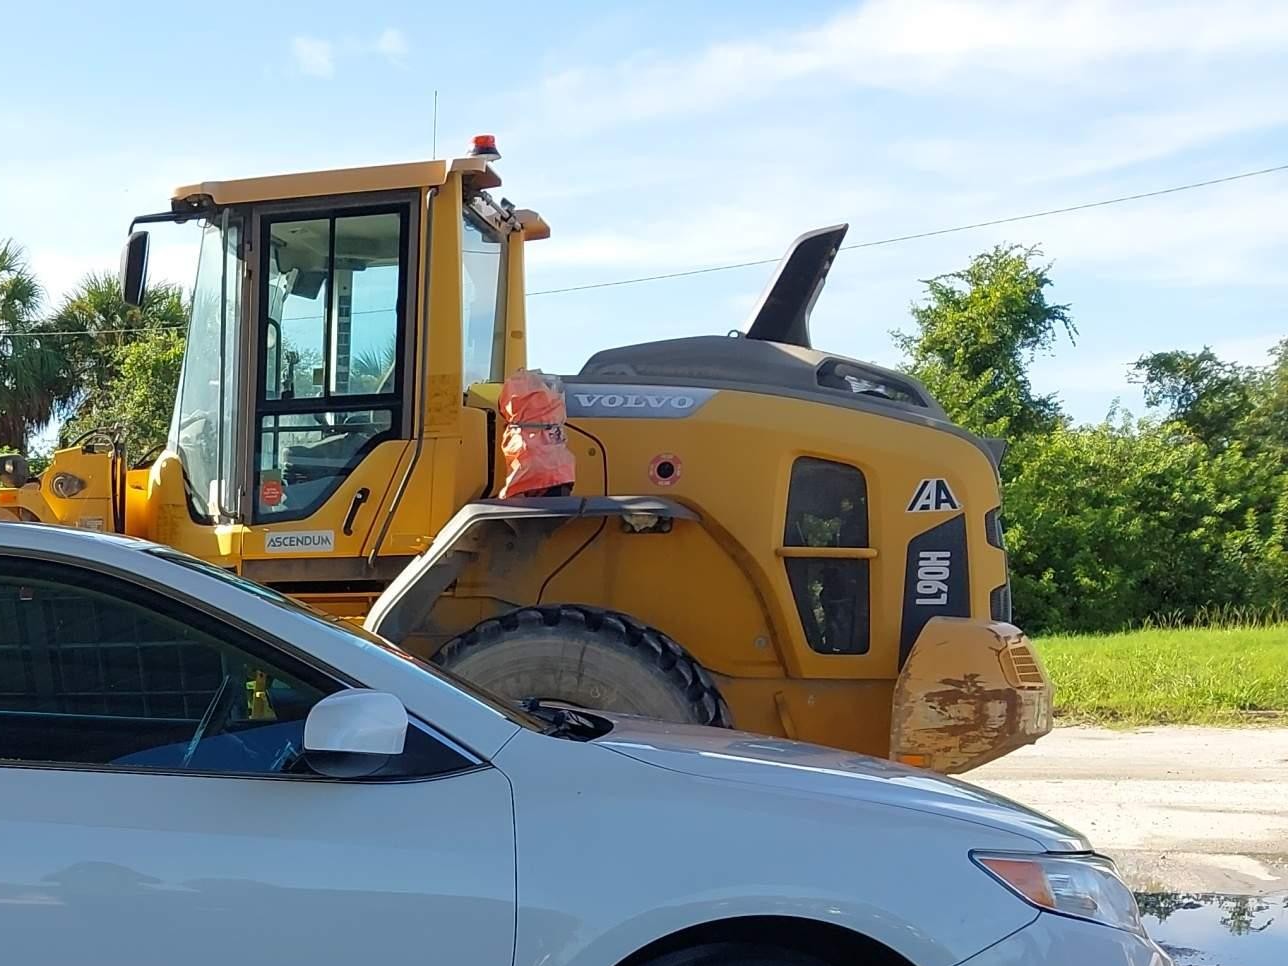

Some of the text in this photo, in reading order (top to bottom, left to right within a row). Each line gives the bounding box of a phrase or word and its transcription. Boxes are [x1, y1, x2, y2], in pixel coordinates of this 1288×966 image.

[573, 394, 694, 409] VOLVO
[267, 535, 332, 548] ASCENDUM
[915, 551, 951, 605] L90H
